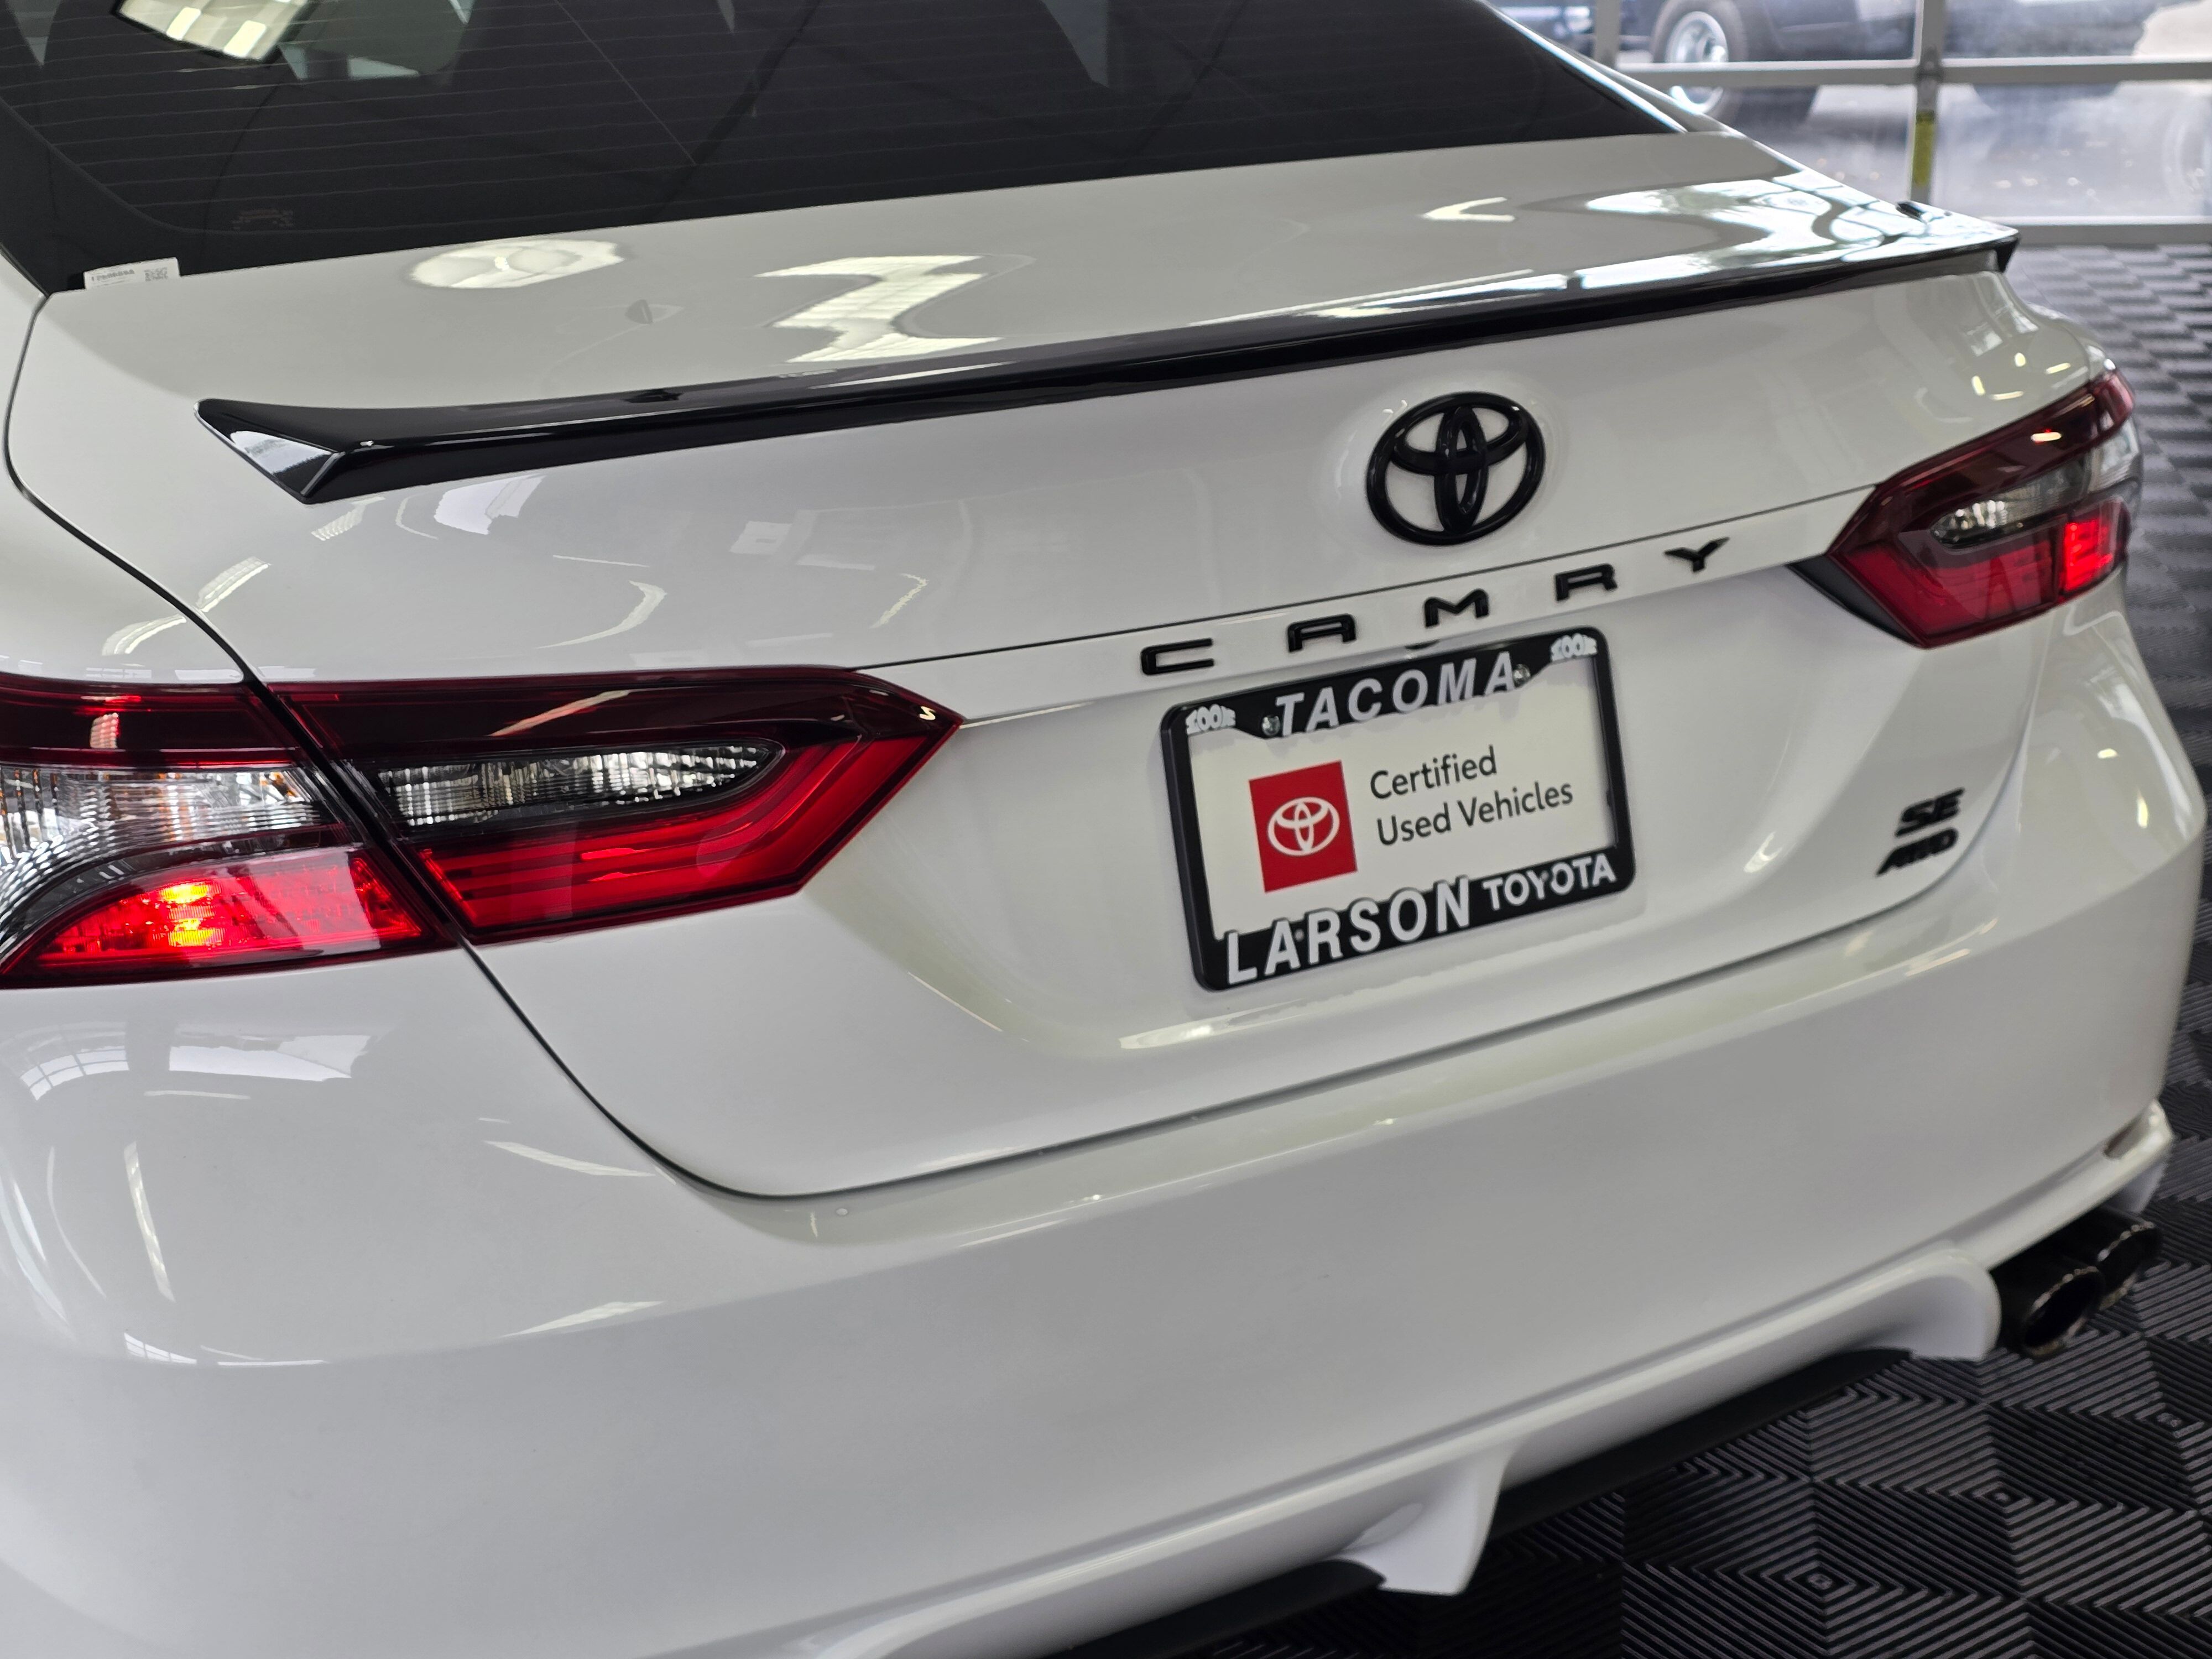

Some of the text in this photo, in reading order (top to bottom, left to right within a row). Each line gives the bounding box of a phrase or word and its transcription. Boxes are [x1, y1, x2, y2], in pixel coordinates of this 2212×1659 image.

[1141, 536, 1730, 675] CAMRY
[1275, 651, 1516, 737] TACOMA
[1370, 744, 1497, 799] Certified
[1377, 781, 1573, 846] Used Vehicles
[1896, 786, 1965, 837] SE
[1227, 853, 1616, 985] LARSON TOYOTA
